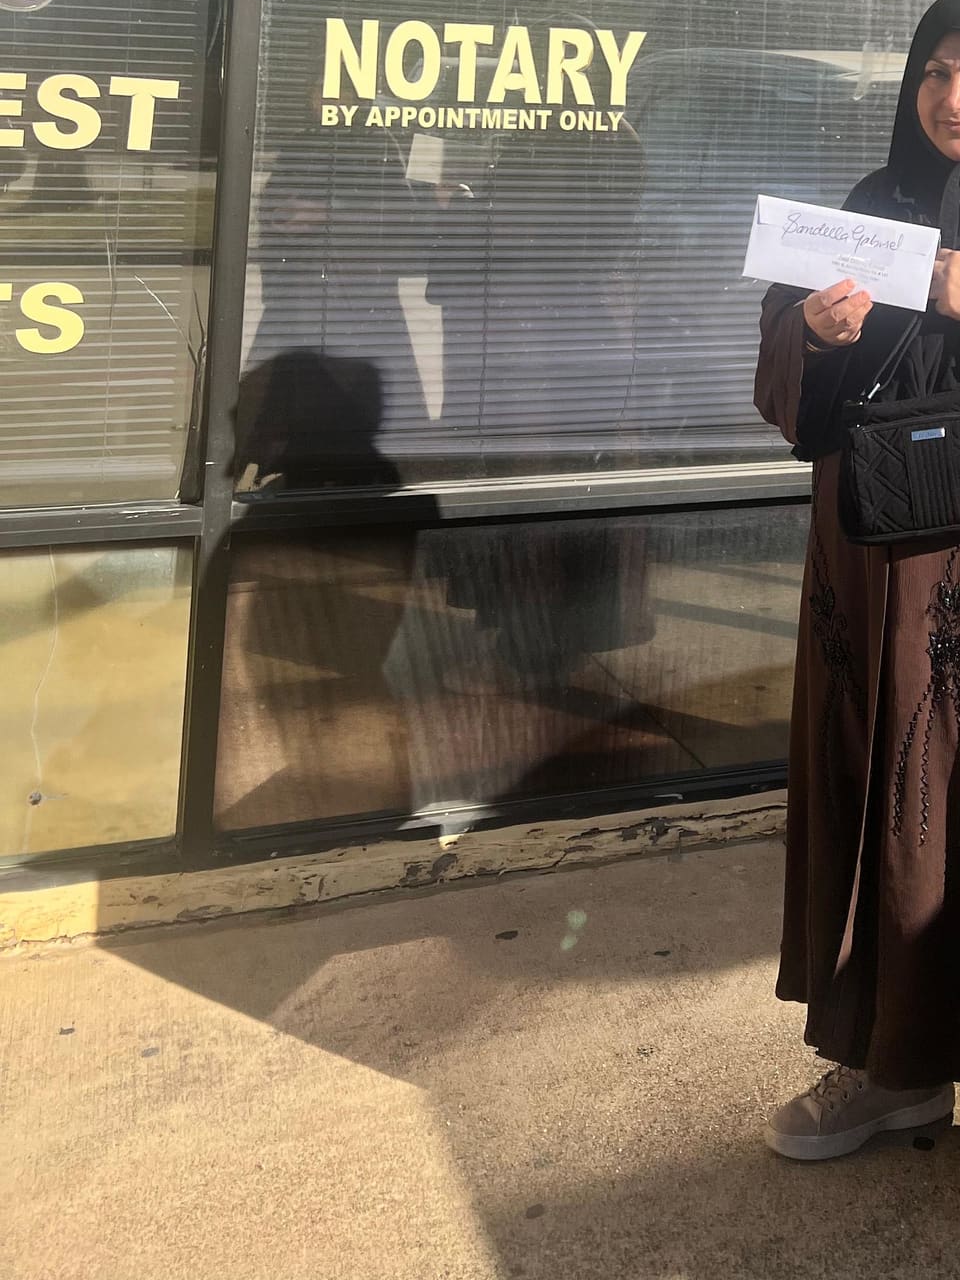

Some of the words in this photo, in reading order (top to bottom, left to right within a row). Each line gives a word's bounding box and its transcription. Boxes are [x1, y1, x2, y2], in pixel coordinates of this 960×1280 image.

[322, 18, 647, 106] NOTARY
[321, 105, 358, 127] BY
[365, 107, 552, 131] APPOINTMENT
[559, 111, 624, 132] ONLY
[0, 281, 85, 355] S
